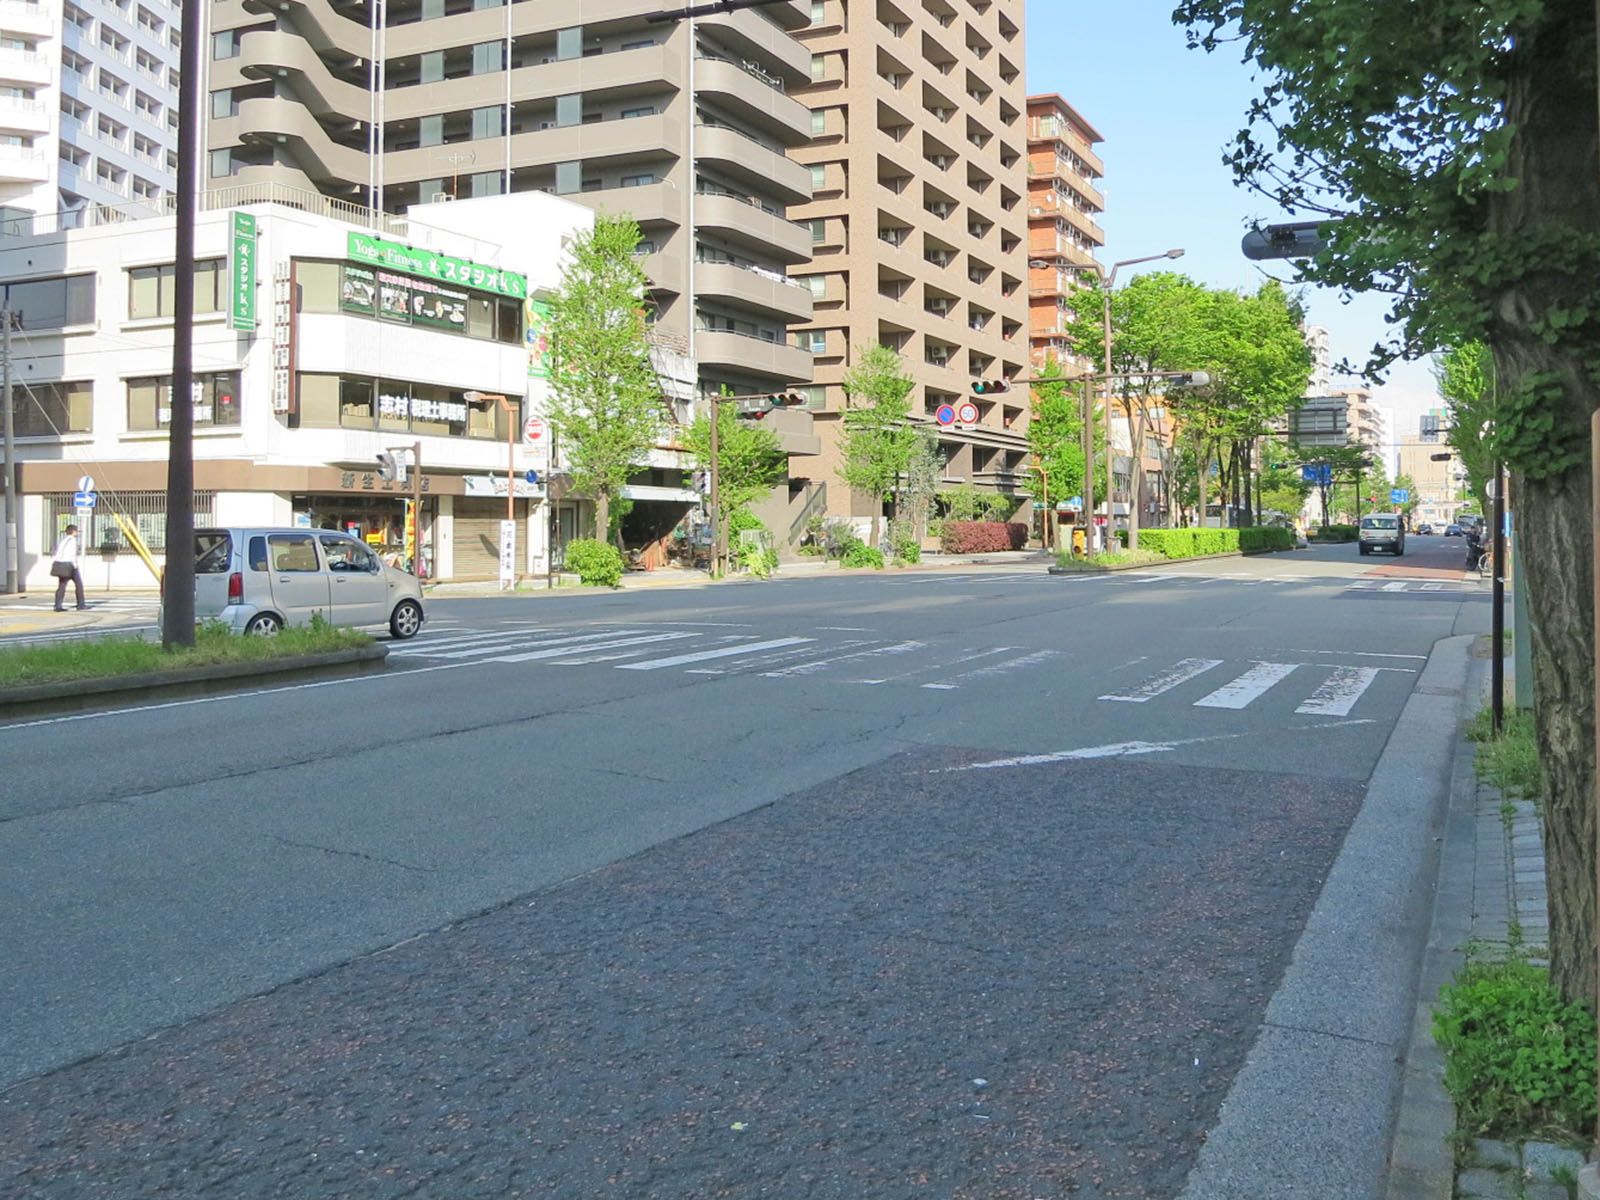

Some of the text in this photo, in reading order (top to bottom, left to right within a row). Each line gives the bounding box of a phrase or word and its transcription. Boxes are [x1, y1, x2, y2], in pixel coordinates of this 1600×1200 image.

[353, 238, 423, 270] Yoga Fitness
[962, 408, 974, 419] 50
